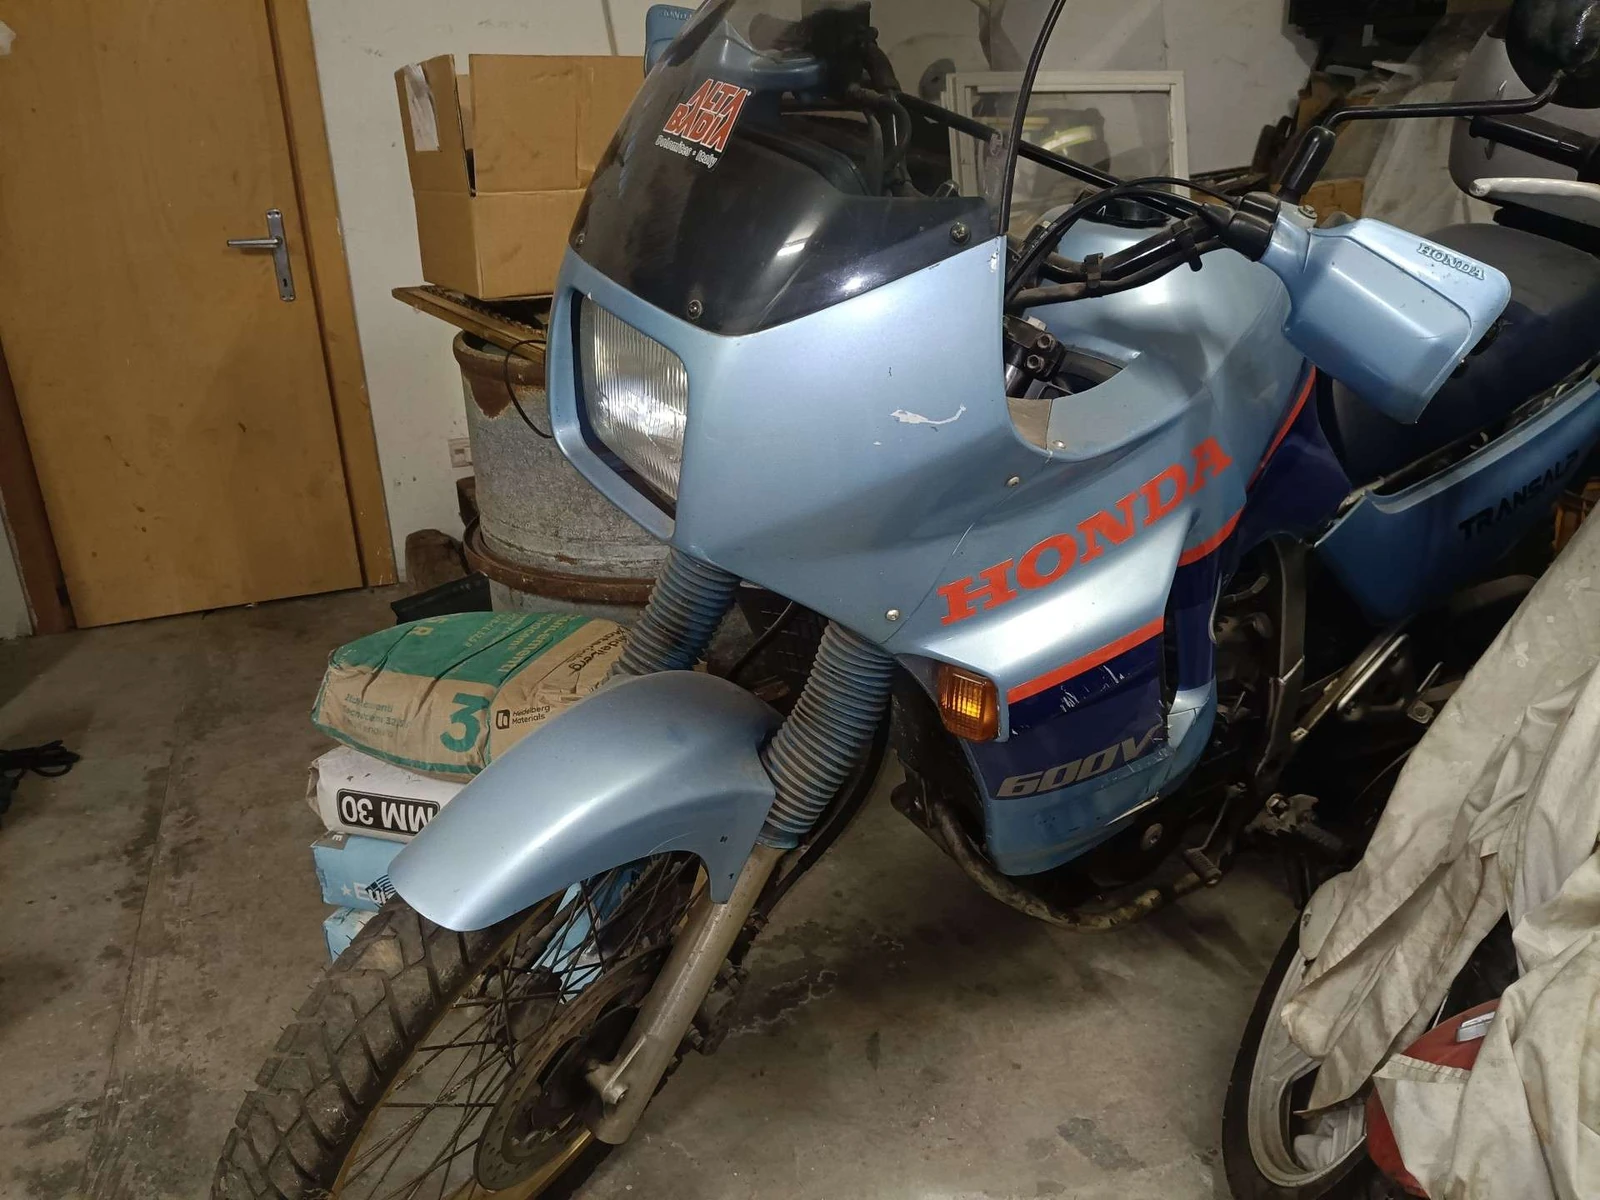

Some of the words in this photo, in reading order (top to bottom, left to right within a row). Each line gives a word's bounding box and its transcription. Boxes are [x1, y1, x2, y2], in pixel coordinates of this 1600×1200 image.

[687, 79, 748, 117] ALTA
[663, 103, 736, 153] BADIA
[1416, 243, 1485, 281] HONDA
[937, 436, 1232, 626] HONDA
[440, 692, 490, 753] 3
[512, 714, 546, 725] Materials
[341, 795, 374, 825] 30
[381, 801, 434, 832] MM
